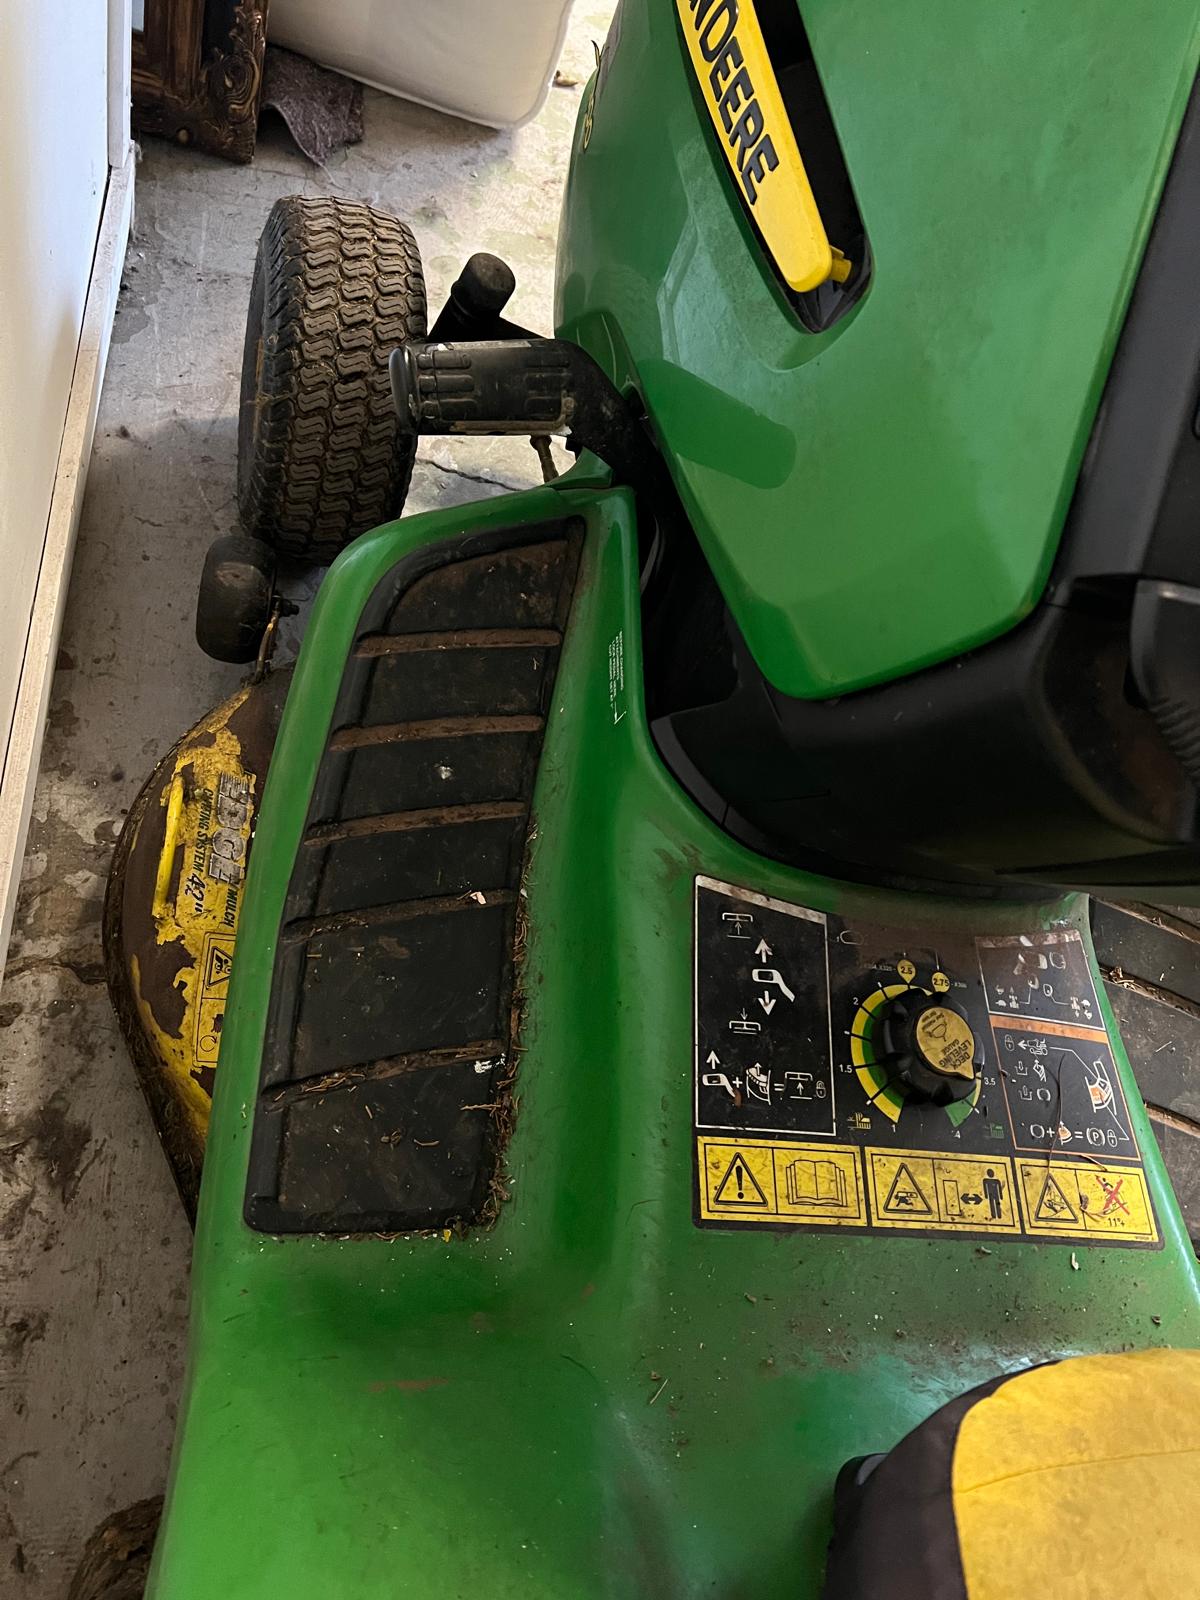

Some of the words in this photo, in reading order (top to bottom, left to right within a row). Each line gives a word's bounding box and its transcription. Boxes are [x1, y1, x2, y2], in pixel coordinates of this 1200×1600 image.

[699, 0, 779, 206] DEERE
[209, 771, 250, 886] EDGE
[193, 831, 209, 873] SYSTEM
[223, 887, 239, 928] MULCH
[900, 965, 913, 975] 2.5
[933, 978, 949, 987] 2.75
[853, 997, 859, 1006] 2
[939, 1039, 972, 1068] LEVELING
[951, 1052, 971, 1070] DECK
[839, 1064, 853, 1074] 1.5
[984, 1077, 996, 1086] 3.5
[891, 1124, 896, 1132] 1
[954, 1130, 961, 1139] 4
